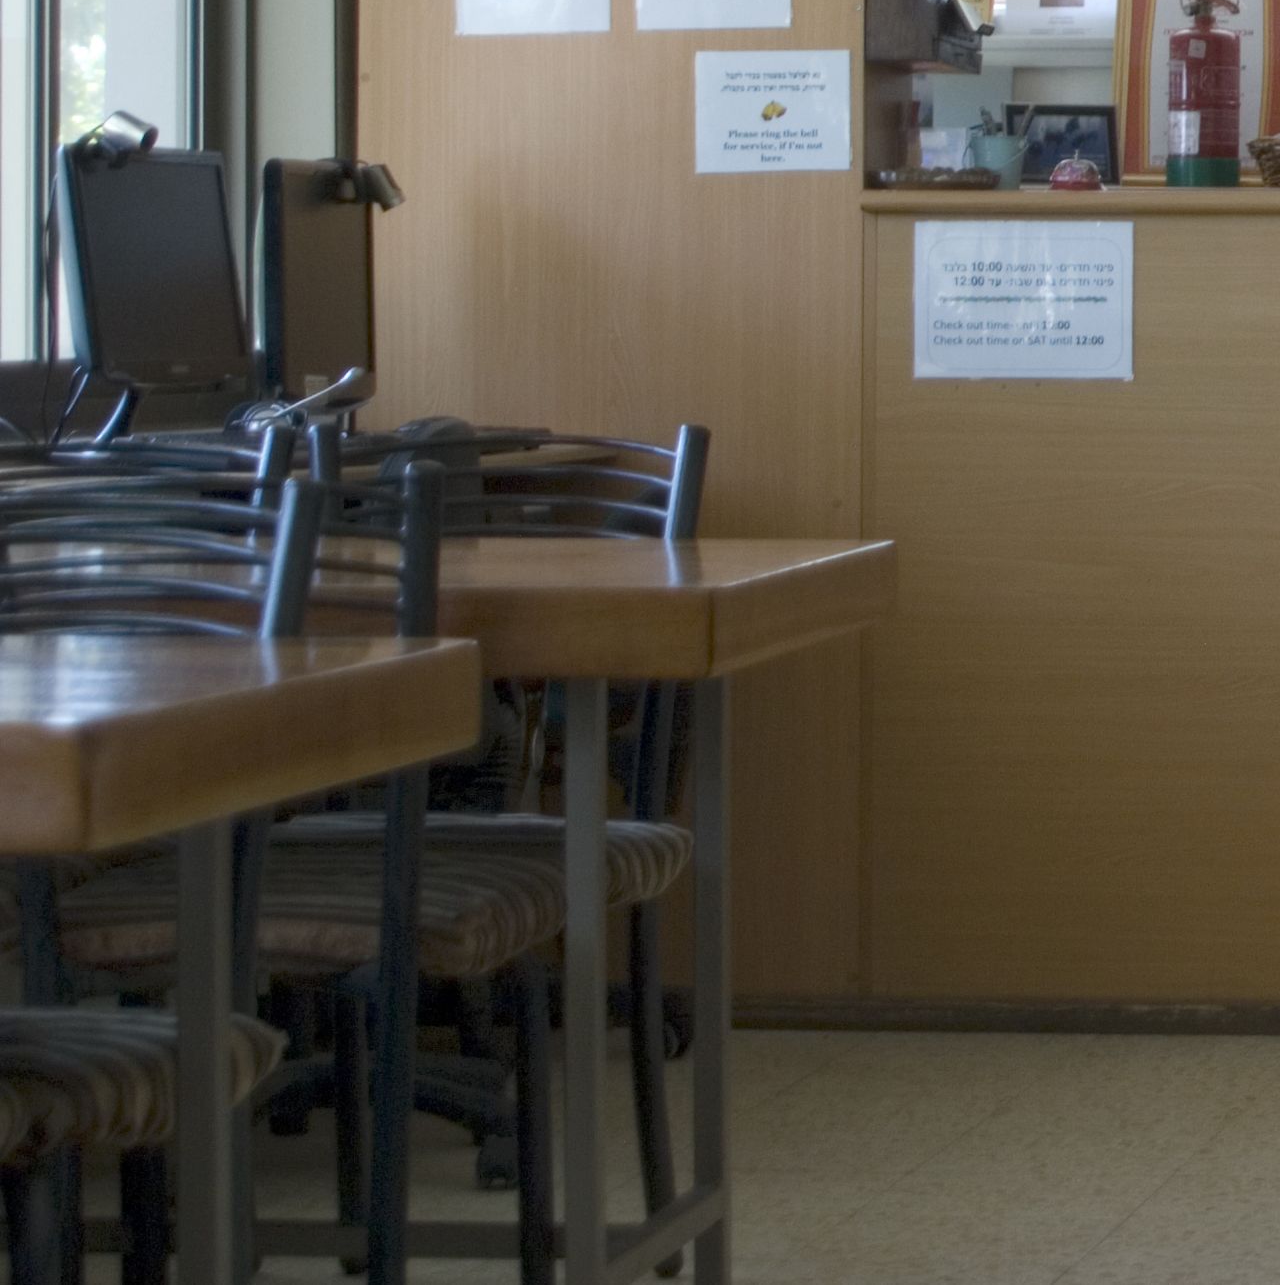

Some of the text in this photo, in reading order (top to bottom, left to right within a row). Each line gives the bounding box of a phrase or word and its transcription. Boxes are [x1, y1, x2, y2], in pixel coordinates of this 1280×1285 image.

[728, 128, 819, 139] Please ring the bell
[723, 141, 738, 151] for
[806, 141, 823, 150] not
[760, 153, 786, 163] here.
[971, 261, 1002, 272] 10:00
[953, 275, 985, 286] 12:00
[933, 319, 963, 330] Check
[966, 320, 984, 330] out
[933, 334, 963, 346] Check
[966, 336, 984, 346] out
[986, 334, 1010, 346] time
[1027, 335, 1046, 346] SAT
[1048, 335, 1073, 346] until
[1075, 334, 1105, 346] 12:00
